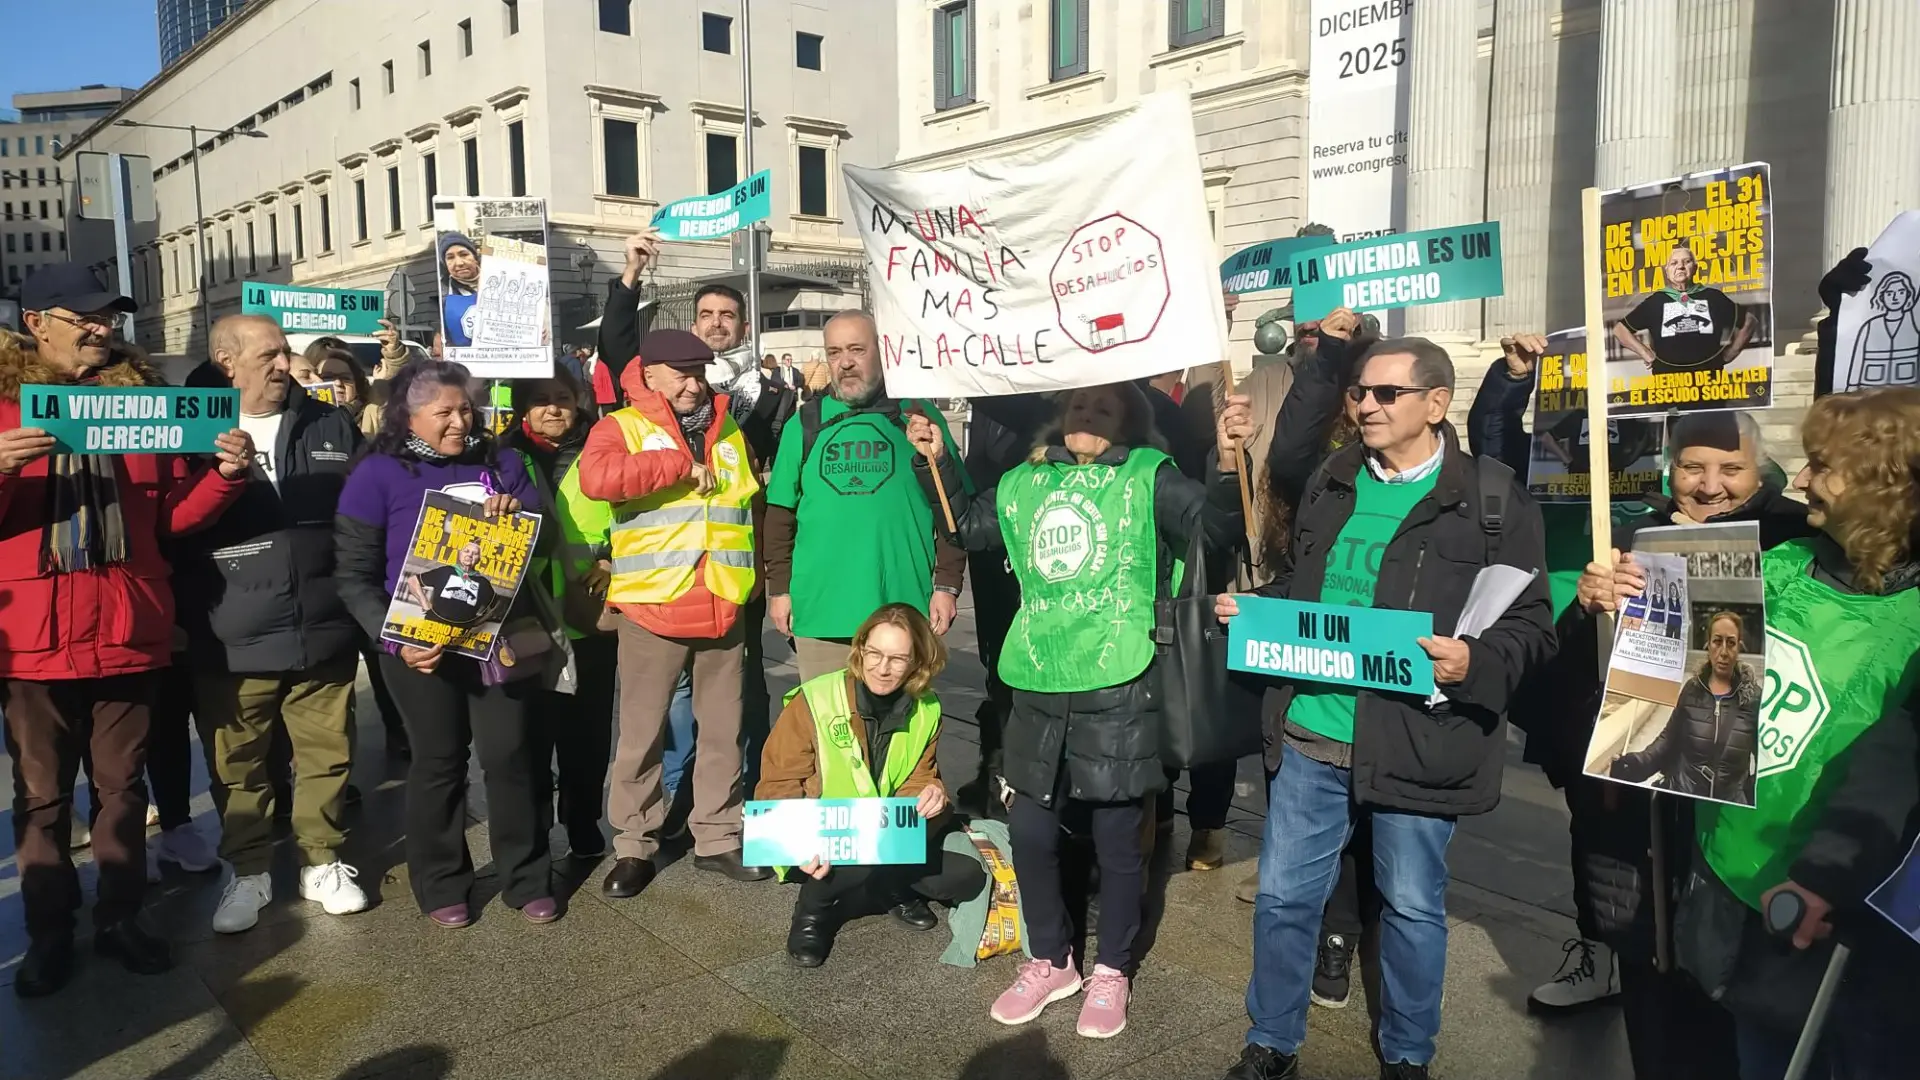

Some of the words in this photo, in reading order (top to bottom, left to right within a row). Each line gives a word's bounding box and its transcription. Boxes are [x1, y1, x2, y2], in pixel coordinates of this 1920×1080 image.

[1339, 38, 1406, 80] 2025
[1313, 138, 1364, 159] Reserva
[1368, 134, 1382, 149] tu
[670, 194, 732, 217] VIVIENDA
[734, 186, 747, 207] ES
[750, 176, 765, 198] UN
[1706, 180, 1732, 208] EL
[1737, 174, 1763, 202] 31
[679, 210, 740, 237] DERECHO
[1606, 222, 1632, 249] DE
[1640, 202, 1763, 243] DICIEMBRE
[1072, 227, 1126, 264] STOP
[1297, 258, 1319, 285] LA
[1324, 240, 1421, 280] VIVIENDA
[1427, 237, 1454, 265] ES
[1461, 231, 1492, 260] UN
[1606, 246, 1635, 273] NO
[1644, 239, 1679, 268] ME
[1689, 227, 1764, 260] DEJES
[1235, 252, 1250, 271] NI
[1252, 247, 1273, 266] UN
[1607, 271, 1633, 298] EN
[1639, 267, 1666, 294] LA
[1693, 253, 1764, 285] CALLE
[248, 288, 265, 306] LA
[270, 290, 336, 311] VIVIENDA
[341, 294, 357, 311] ES
[361, 296, 379, 311] UN
[1343, 272, 1441, 309] DERECHO
[921, 288, 999, 320] MAS
[282, 312, 347, 330] DERECHO
[1541, 355, 1563, 376] DE
[1540, 374, 1564, 392] NO
[1629, 373, 1692, 391] GOBIERNO
[1695, 369, 1729, 387] DEJA
[1732, 366, 1768, 383] CAER
[1540, 390, 1562, 412] EN
[1565, 391, 1589, 411] LA
[1630, 390, 1646, 406] EL
[1647, 386, 1700, 405] ESCUDO
[1702, 382, 1750, 401] SOCIAL
[31, 394, 60, 419] LA
[68, 395, 167, 420] VIVIENDA
[175, 396, 200, 419] ES
[206, 396, 233, 419] UN
[86, 425, 183, 450] DERECHO
[825, 440, 888, 462] STOP
[824, 461, 889, 475] DESAHUCIOS
[1060, 466, 1116, 489] CASA
[1547, 484, 1558, 495] EL
[424, 506, 447, 528] DE
[451, 513, 533, 551] DICIEMBRE
[498, 514, 514, 530] EL
[518, 517, 536, 535] 31
[1038, 525, 1082, 549] STOP
[418, 523, 444, 544] NO
[448, 531, 475, 551] ME
[478, 540, 526, 567] DEJES
[1039, 542, 1082, 560] DESAHUCIOS
[414, 540, 437, 562] EN
[438, 546, 458, 566] LA
[474, 557, 522, 582] CALLE
[1061, 586, 1114, 614] CASA
[400, 624, 414, 638] EL
[413, 627, 451, 645] ESCUDO
[1298, 610, 1317, 640] NI
[1323, 613, 1350, 644] UN
[1244, 639, 1355, 680] DESAHUCIO
[1361, 650, 1412, 687] MÁS
[879, 806, 889, 829] S
[895, 805, 919, 829] UN
